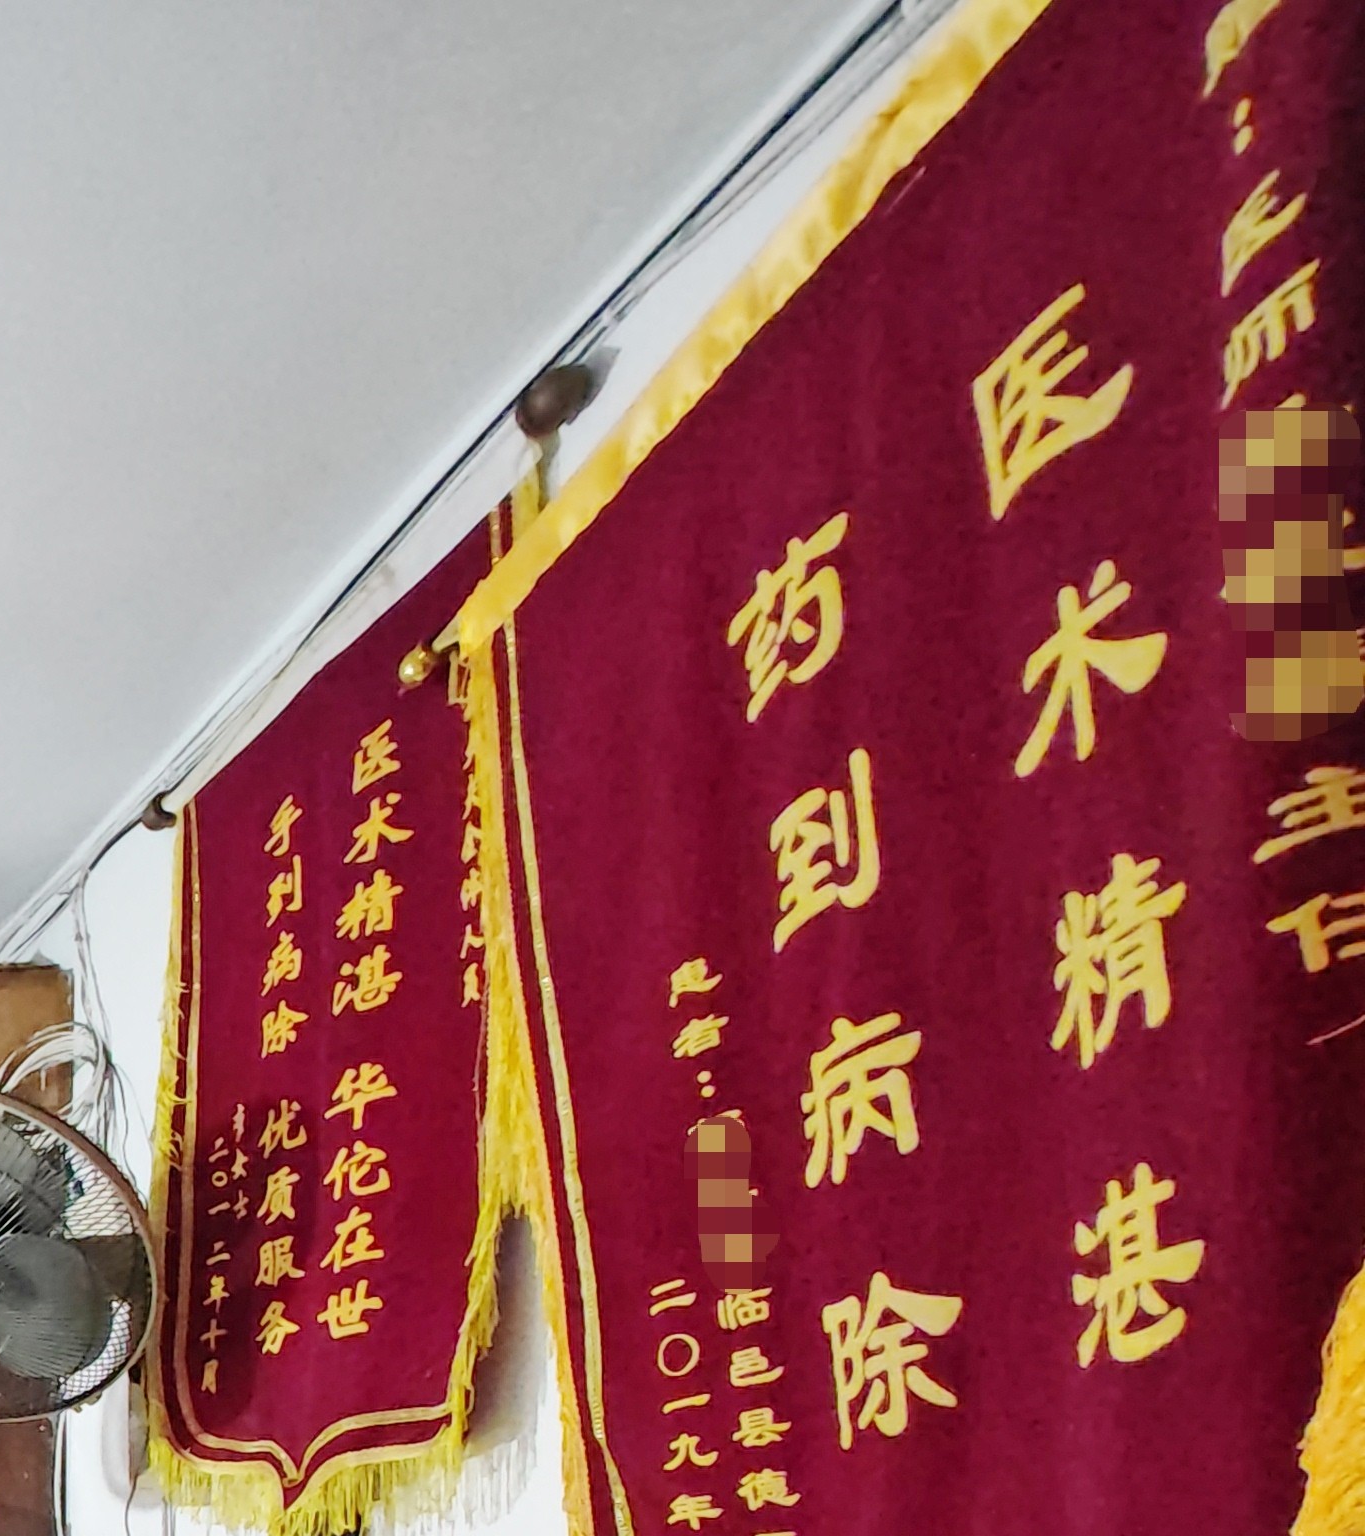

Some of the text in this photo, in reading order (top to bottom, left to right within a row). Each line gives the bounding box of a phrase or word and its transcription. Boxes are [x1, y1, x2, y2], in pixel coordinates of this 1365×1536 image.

[254, 794, 310, 1356] 手到病除 优质服务
[316, 717, 416, 1342] 医术精湛 华佗在世
[727, 511, 963, 1453] 药到病除
[972, 281, 1208, 1370] 医术精湛
